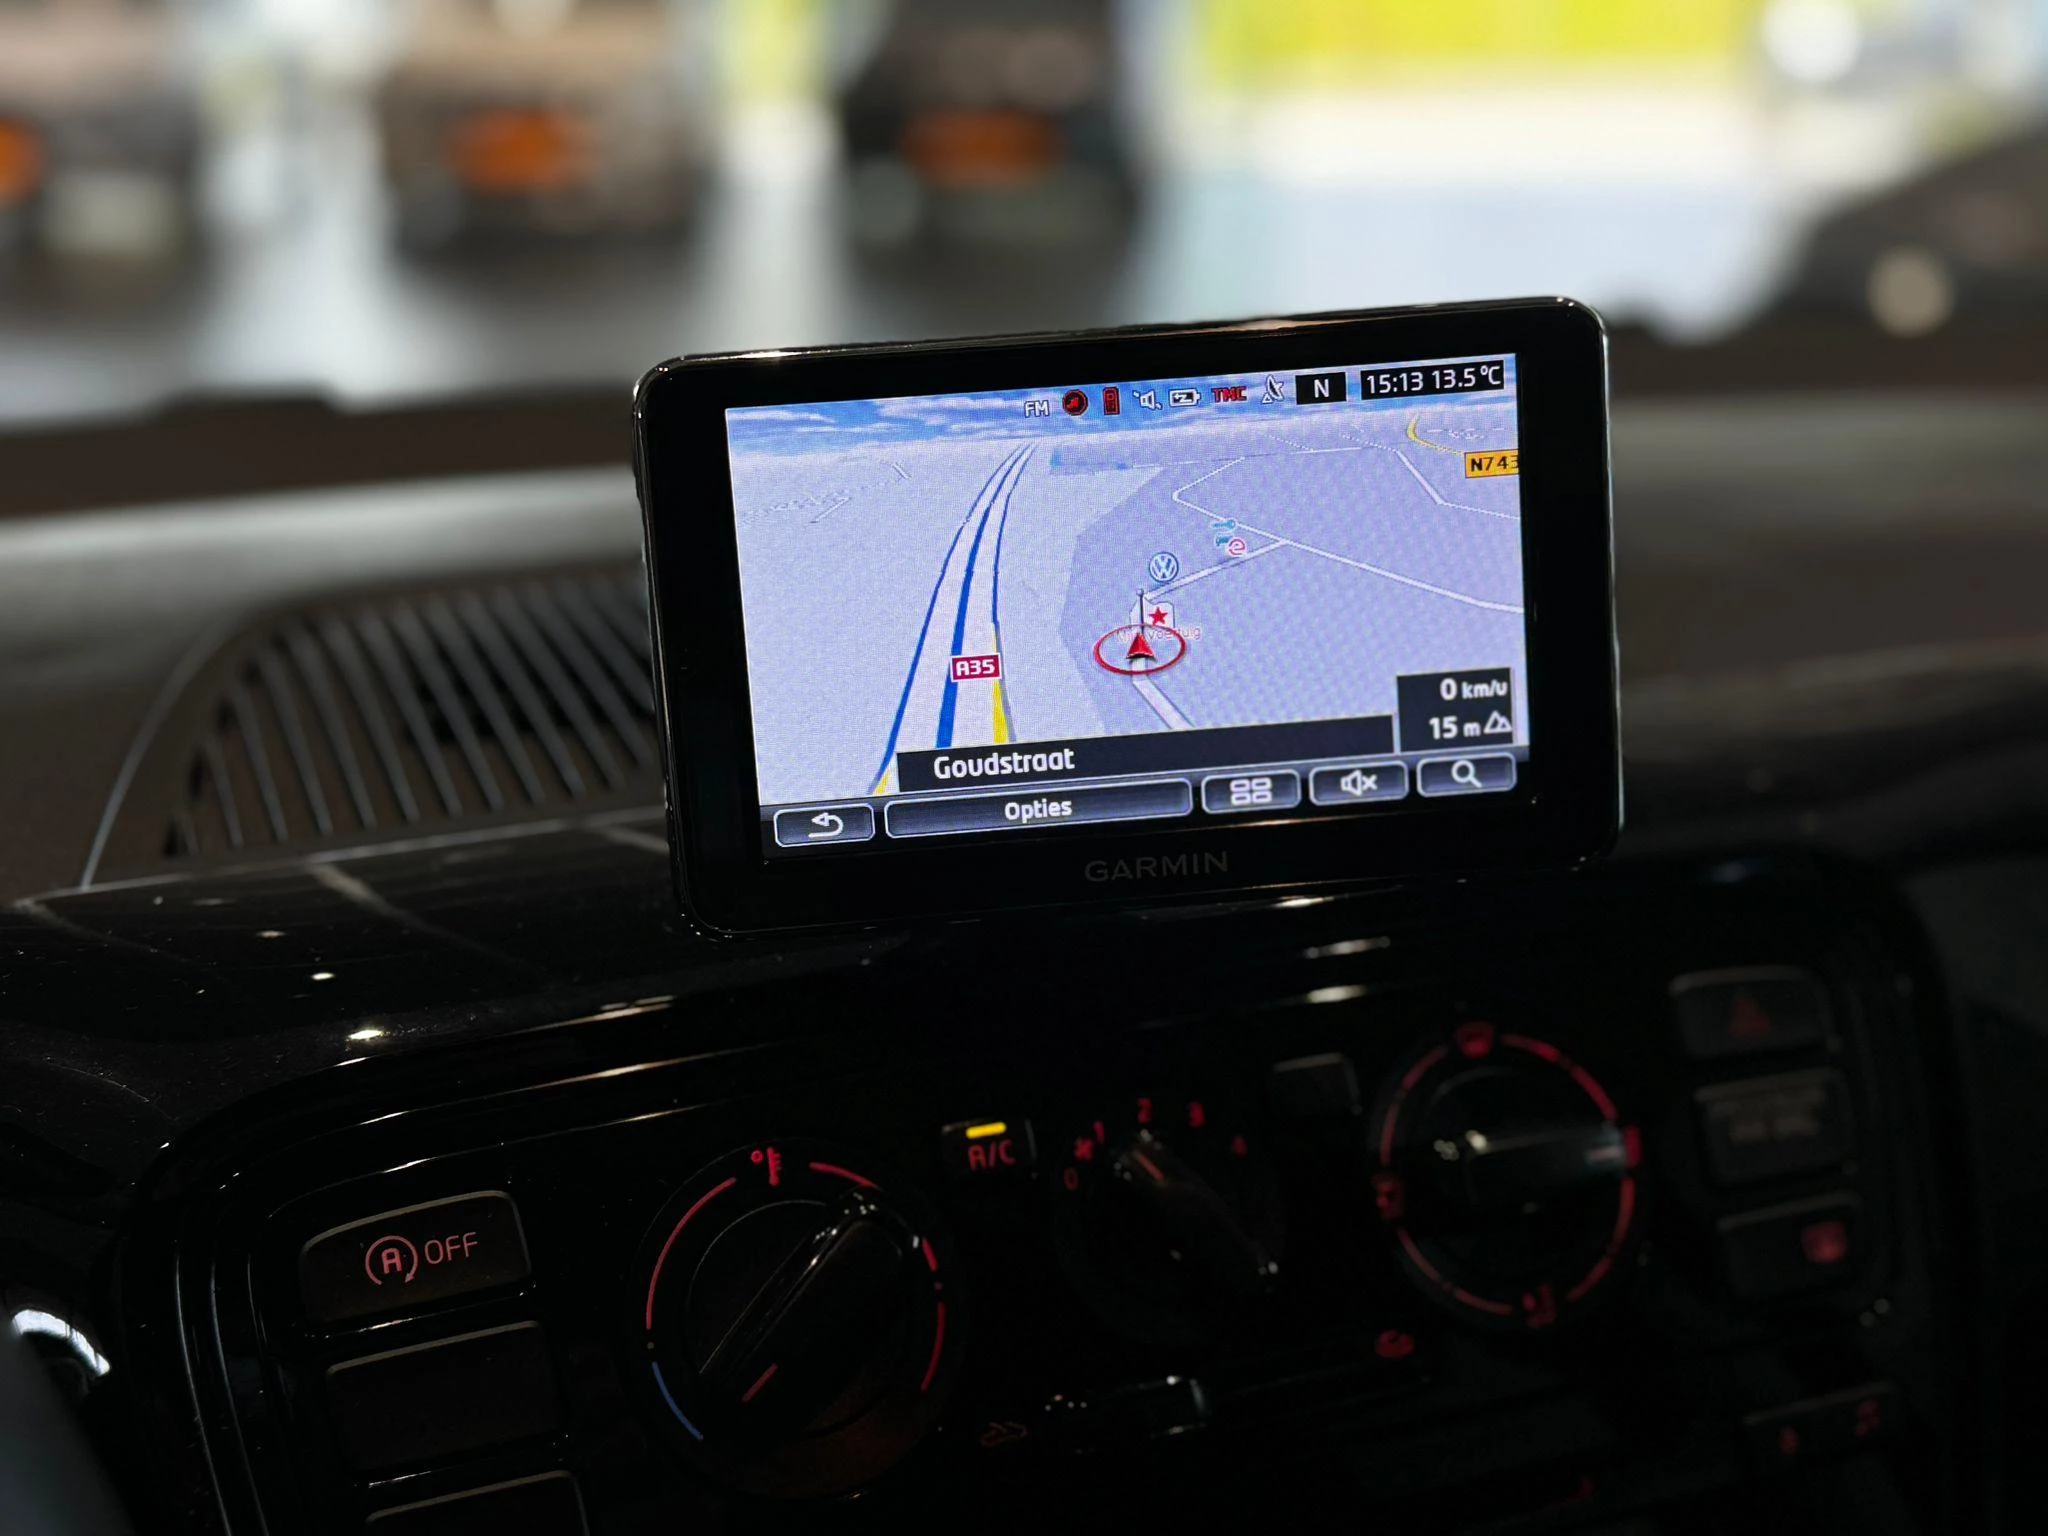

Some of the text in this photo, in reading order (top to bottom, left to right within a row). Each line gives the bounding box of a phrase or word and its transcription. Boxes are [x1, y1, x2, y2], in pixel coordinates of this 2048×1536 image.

[1211, 386, 1247, 403] TMC
[1313, 378, 1330, 398] N
[1366, 371, 1423, 394] 15:13
[1024, 400, 1049, 417] FM
[1148, 624, 1202, 642] voeuig
[955, 658, 996, 677] A35
[1440, 677, 1508, 701] 0 km/u
[1429, 715, 1481, 740] 15 m
[933, 748, 1075, 779] Goudstraat
[1004, 798, 1073, 823] Opties
[1084, 851, 1228, 882] GARMIN
[967, 1138, 1016, 1171] A/C
[381, 1232, 478, 1274] A OFF
